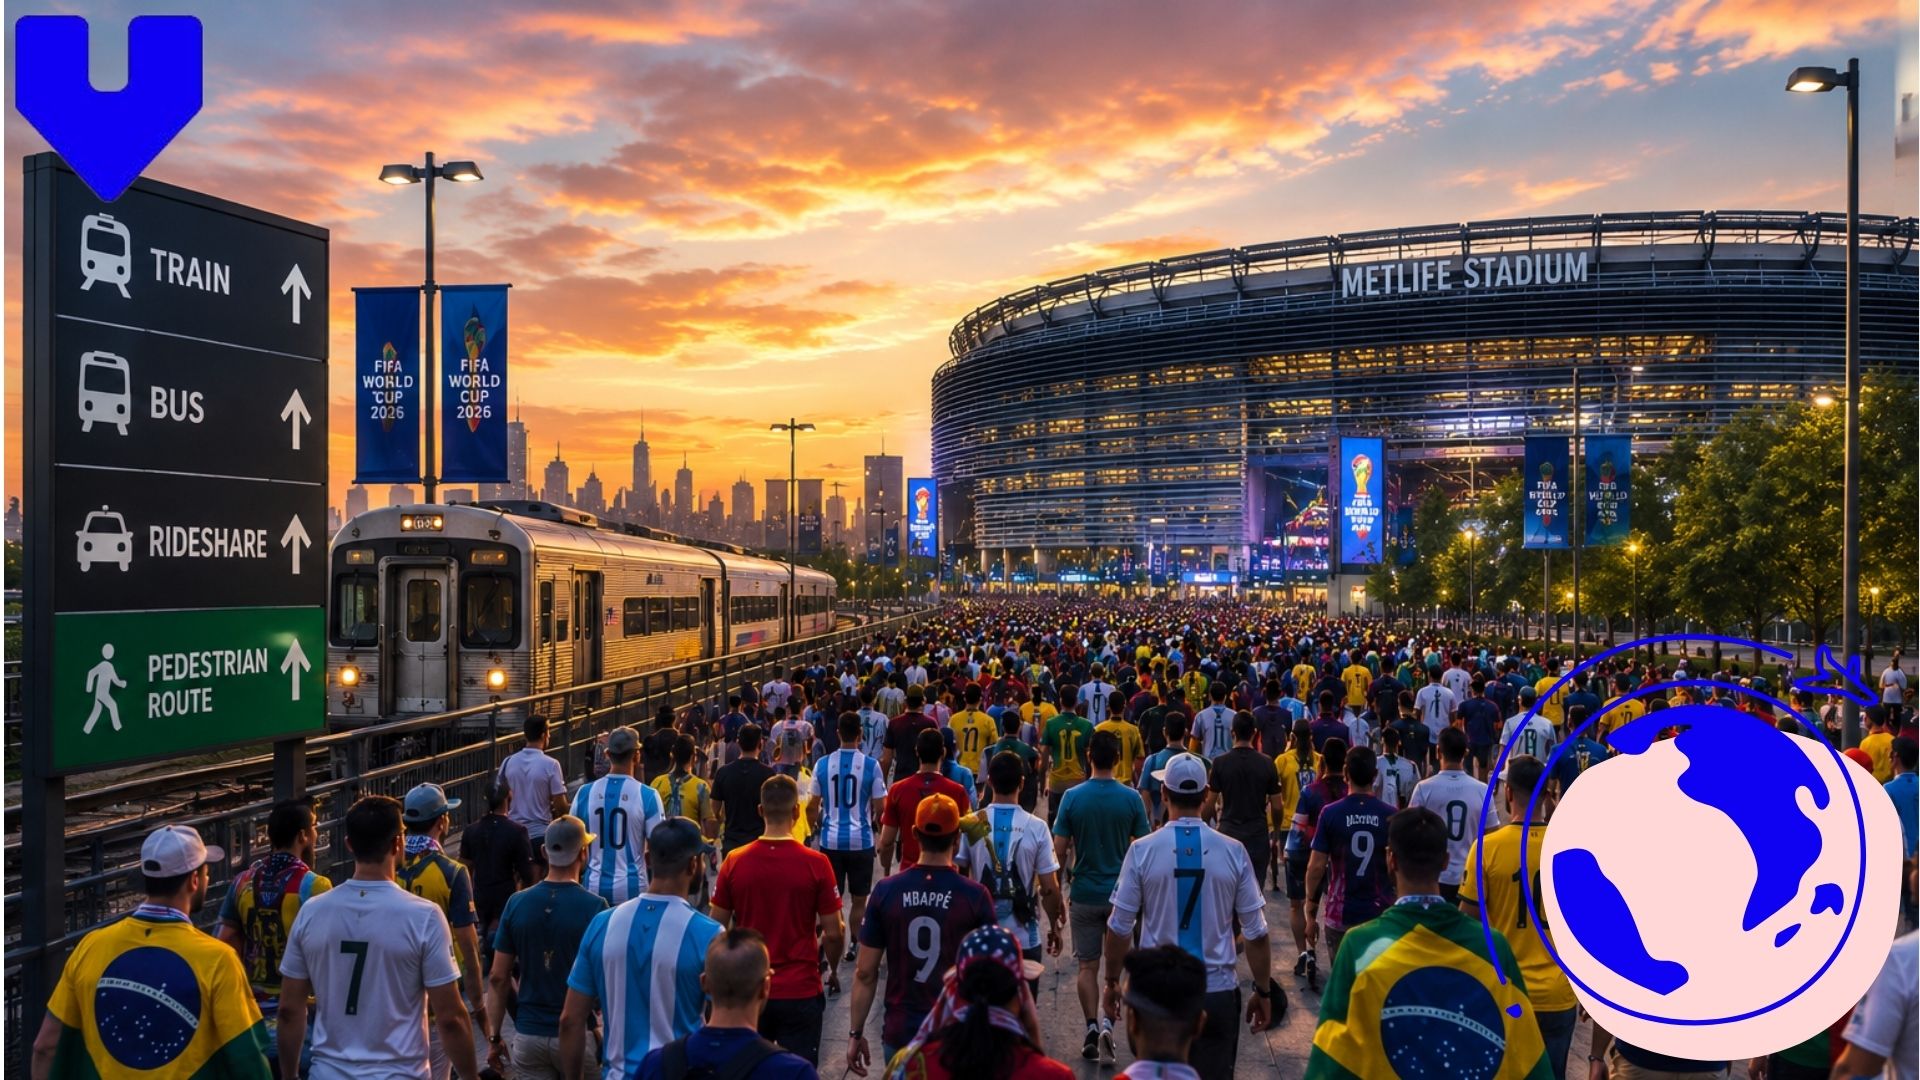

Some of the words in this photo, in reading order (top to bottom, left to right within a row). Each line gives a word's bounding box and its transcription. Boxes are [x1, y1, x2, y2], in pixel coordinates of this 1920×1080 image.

[150, 248, 230, 295] TRAIN
[1342, 259, 1451, 298] METLIFE
[1463, 251, 1588, 289] STADIUM
[363, 375, 413, 388] WORLD
[375, 360, 402, 373] FIFA
[449, 374, 500, 388] WORLD
[462, 358, 489, 372] FIFA
[150, 386, 204, 424] BUS
[371, 405, 404, 419] 2026
[457, 405, 491, 419] 2026
[460, 390, 489, 403] CUP
[149, 525, 267, 558] RIDESHARE
[148, 648, 268, 682] PEDESTRIAN
[148, 688, 213, 719] ROUTE
[831, 773, 858, 809] 10
[594, 806, 628, 850] 10
[1351, 830, 1375, 877] 9
[902, 890, 953, 910] MBAPPÉ
[1174, 868, 1206, 931] 7
[907, 916, 942, 984] 9
[340, 940, 369, 1016] 7
